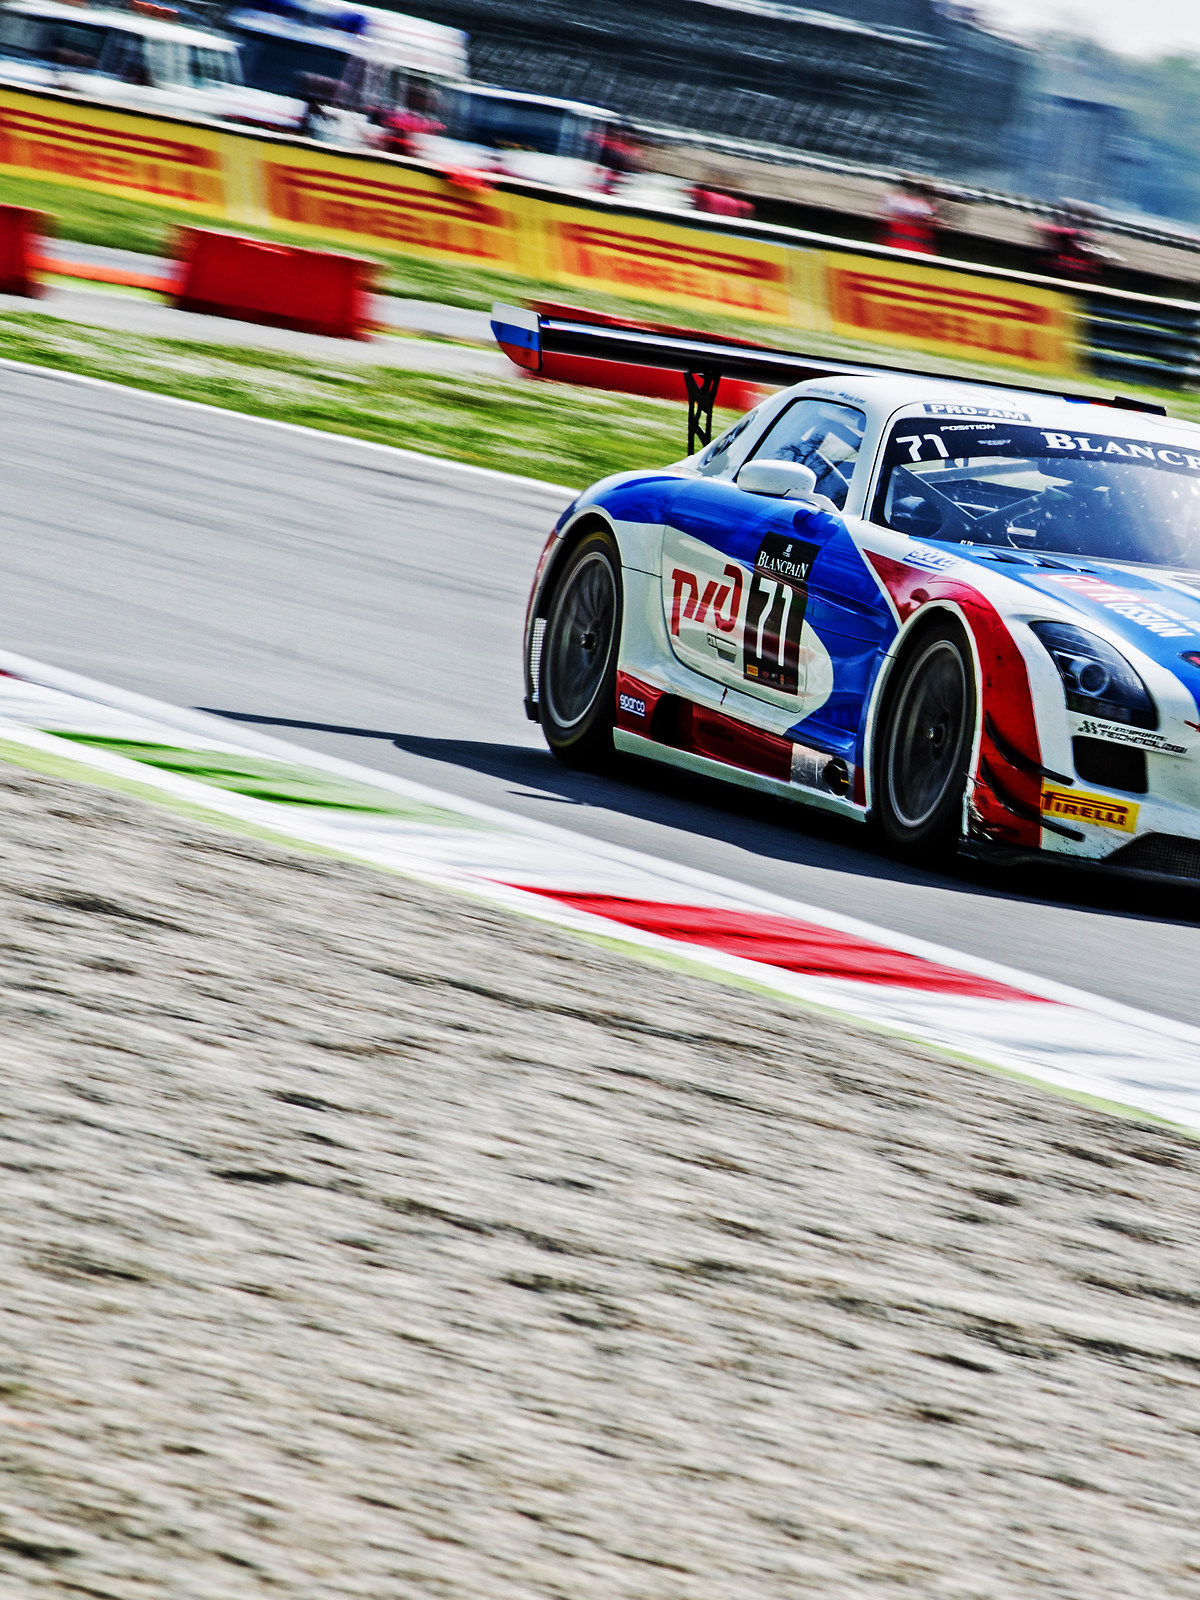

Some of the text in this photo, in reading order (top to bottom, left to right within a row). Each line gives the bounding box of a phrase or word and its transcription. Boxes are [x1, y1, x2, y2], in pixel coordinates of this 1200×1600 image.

[929, 404, 1026, 421] PRO-AM
[939, 423, 996, 432] POSITION
[895, 433, 950, 462] 71
[757, 550, 810, 578] BLANCPAIN
[755, 577, 794, 668] 71
[620, 694, 646, 713] sparco
[1044, 790, 1129, 827] PIRELLI
